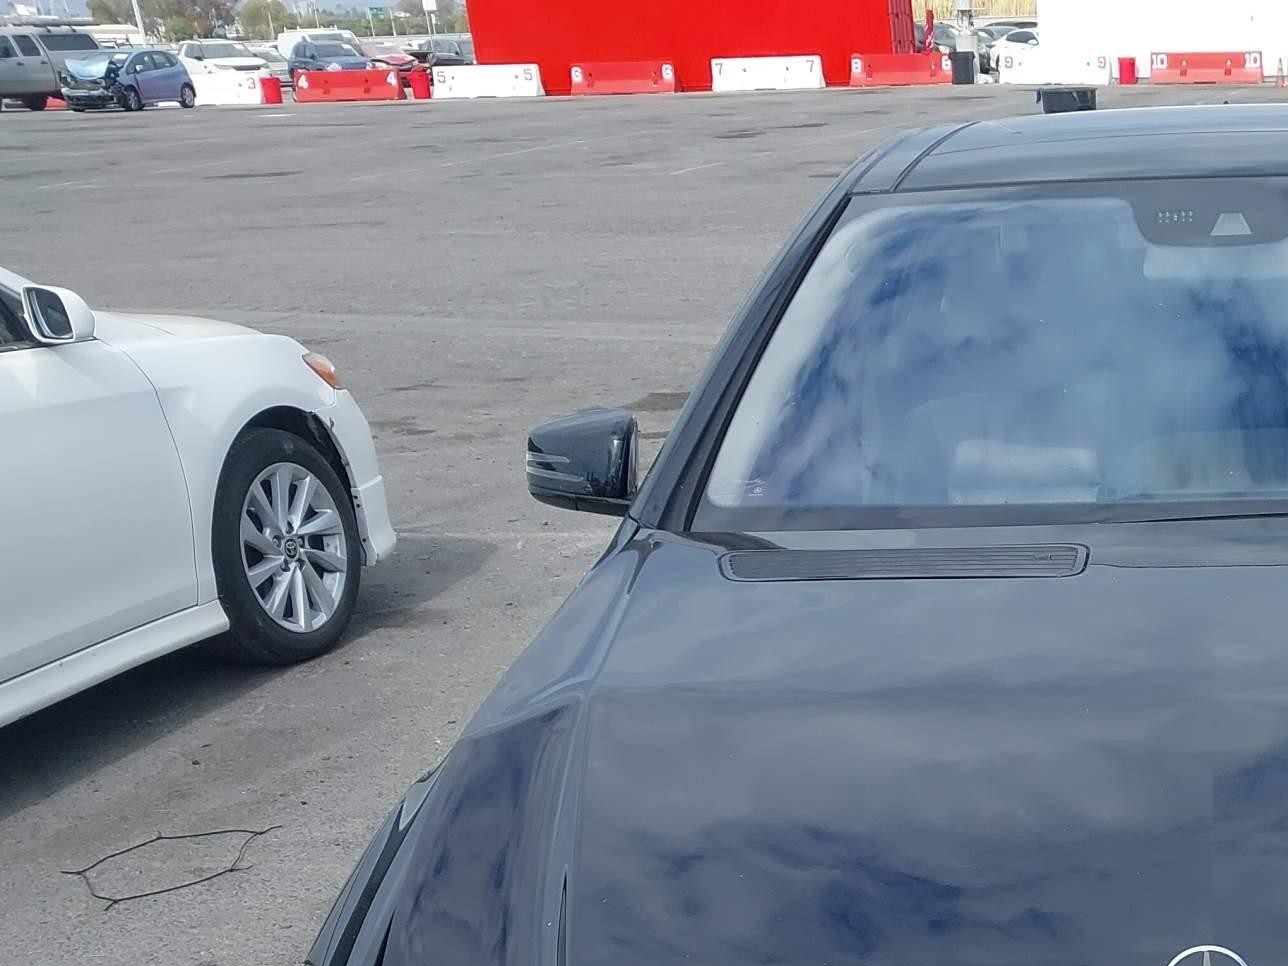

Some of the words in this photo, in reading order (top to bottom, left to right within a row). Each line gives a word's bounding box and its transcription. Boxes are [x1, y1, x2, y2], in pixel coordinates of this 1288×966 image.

[805, 60, 815, 73] 7
[1004, 56, 1013, 69] 9
[1097, 56, 1106, 69] 9
[1151, 53, 1168, 70] 10
[1244, 52, 1261, 69] 10
[523, 68, 533, 81] 5
[571, 66, 583, 82] 6
[661, 64, 673, 80] 6
[714, 62, 723, 75] 7
[247, 77, 256, 90] 3
[297, 74, 309, 89] 4
[386, 71, 397, 86] 4
[436, 70, 446, 84] 5
